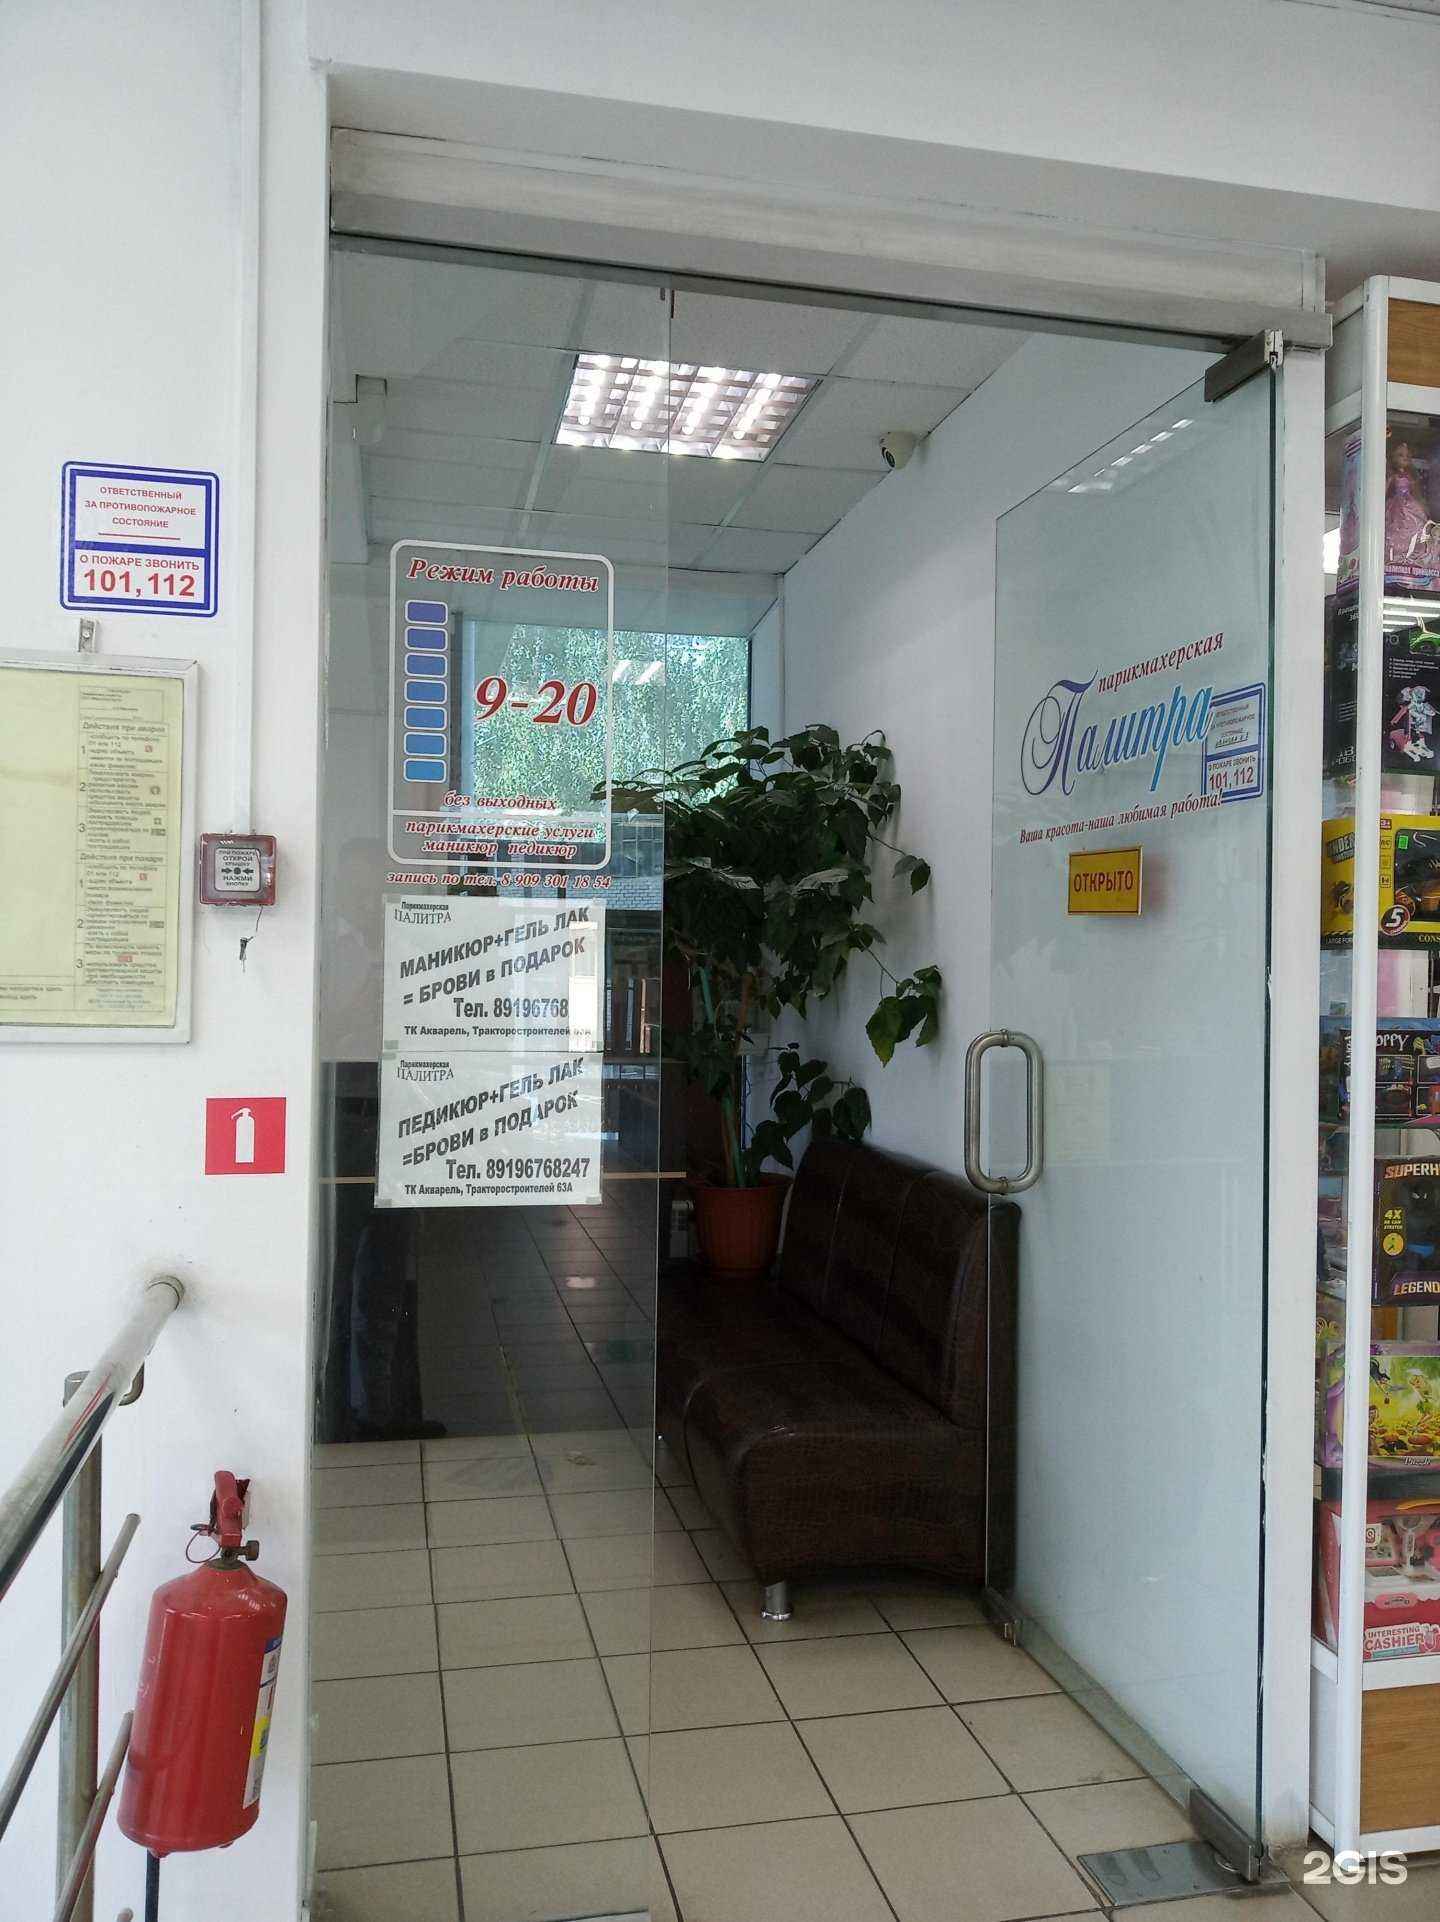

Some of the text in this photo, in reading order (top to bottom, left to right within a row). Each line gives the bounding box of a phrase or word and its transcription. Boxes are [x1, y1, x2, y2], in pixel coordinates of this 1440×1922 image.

[100, 486, 182, 500] ОТВЕТСТВЕННЫЙ
[85, 500, 197, 516] ЗА ПРОТИВОПОЖАРНОЕ
[112, 517, 169, 528] СОСТОЯНИЕ
[80, 554, 199, 570] О ПОЖАРЕ ЗВОНИТЬ
[408, 558, 599, 592] Режим работы
[1099, 632, 1224, 694] парикмахерская
[476, 676, 598, 725] 9-20
[1020, 666, 1214, 796] Палитра
[444, 790, 557, 810] без выходных
[406, 820, 594, 840] парикмахерские услуги
[1020, 828, 1043, 844] Ваша
[1118, 800, 1167, 825] любимая
[422, 840, 577, 858] маникюр педикюр
[387, 872, 611, 888] запись по тел. 8 909 301 18 54
[1073, 870, 1134, 892] ОТКРЫТО
[394, 908, 452, 924] ПАЛИТРА
[1385, 908, 1404, 928] 5
[400, 907, 589, 978] МАНИКЮР+ГЕЛЬ ЛАК
[486, 971, 495, 983] в
[500, 937, 585, 978] ПОДАРОК
[453, 998, 569, 1018] Тел. 89196768
[404, 1026, 417, 1036] ТК
[420, 1026, 470, 1037] Акварель,
[472, 1026, 570, 1036] Тракторостроителей
[398, 1068, 454, 1081] ПАЛИТРА
[398, 1057, 584, 1138] ПЕДИКЮР+ГЕЛЬ ЛАК
[480, 1127, 488, 1142] в
[494, 1090, 578, 1136] ПОДАРОК
[446, 1158, 590, 1180] Тел. 89196768247
[1384, 1162, 1440, 1179] SUPERH
[405, 1183, 573, 1196] ТК Акварель, Тракторостроителей 63А
[1368, 1625, 1420, 1638] INTERESTING
[1365, 1634, 1424, 1650] CASHIER
